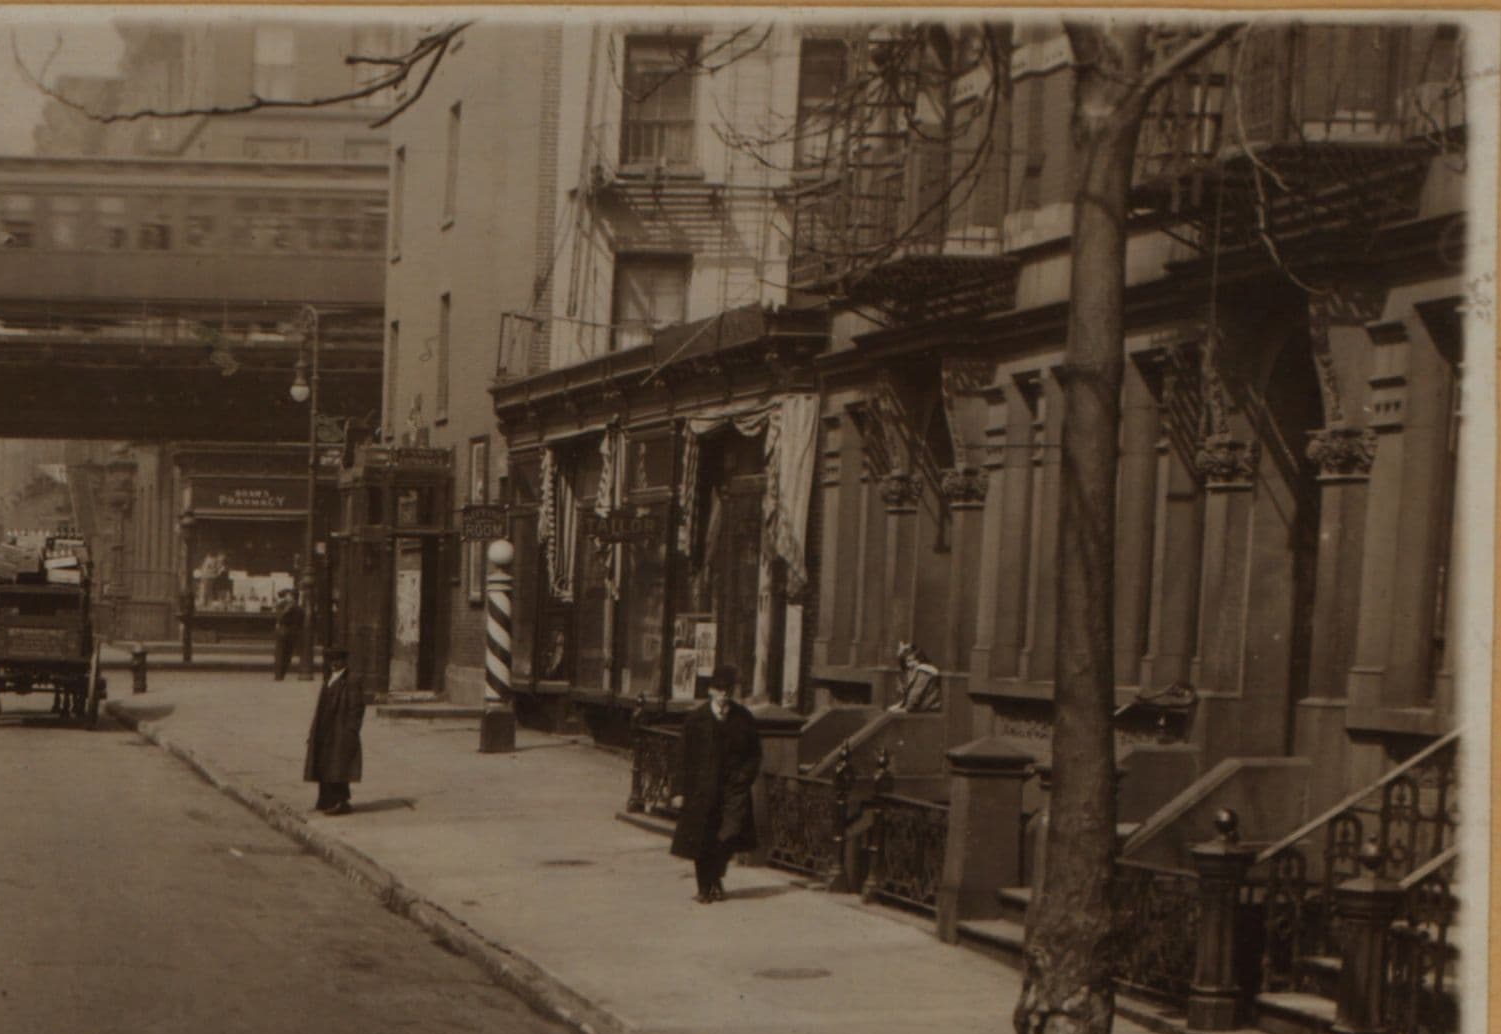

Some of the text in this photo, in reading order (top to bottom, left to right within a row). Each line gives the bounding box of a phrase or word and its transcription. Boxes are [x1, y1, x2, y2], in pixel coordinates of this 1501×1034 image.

[218, 495, 286, 507] PHARMACY
[465, 523, 503, 537] ROOM
[585, 518, 657, 535] TAILOR
